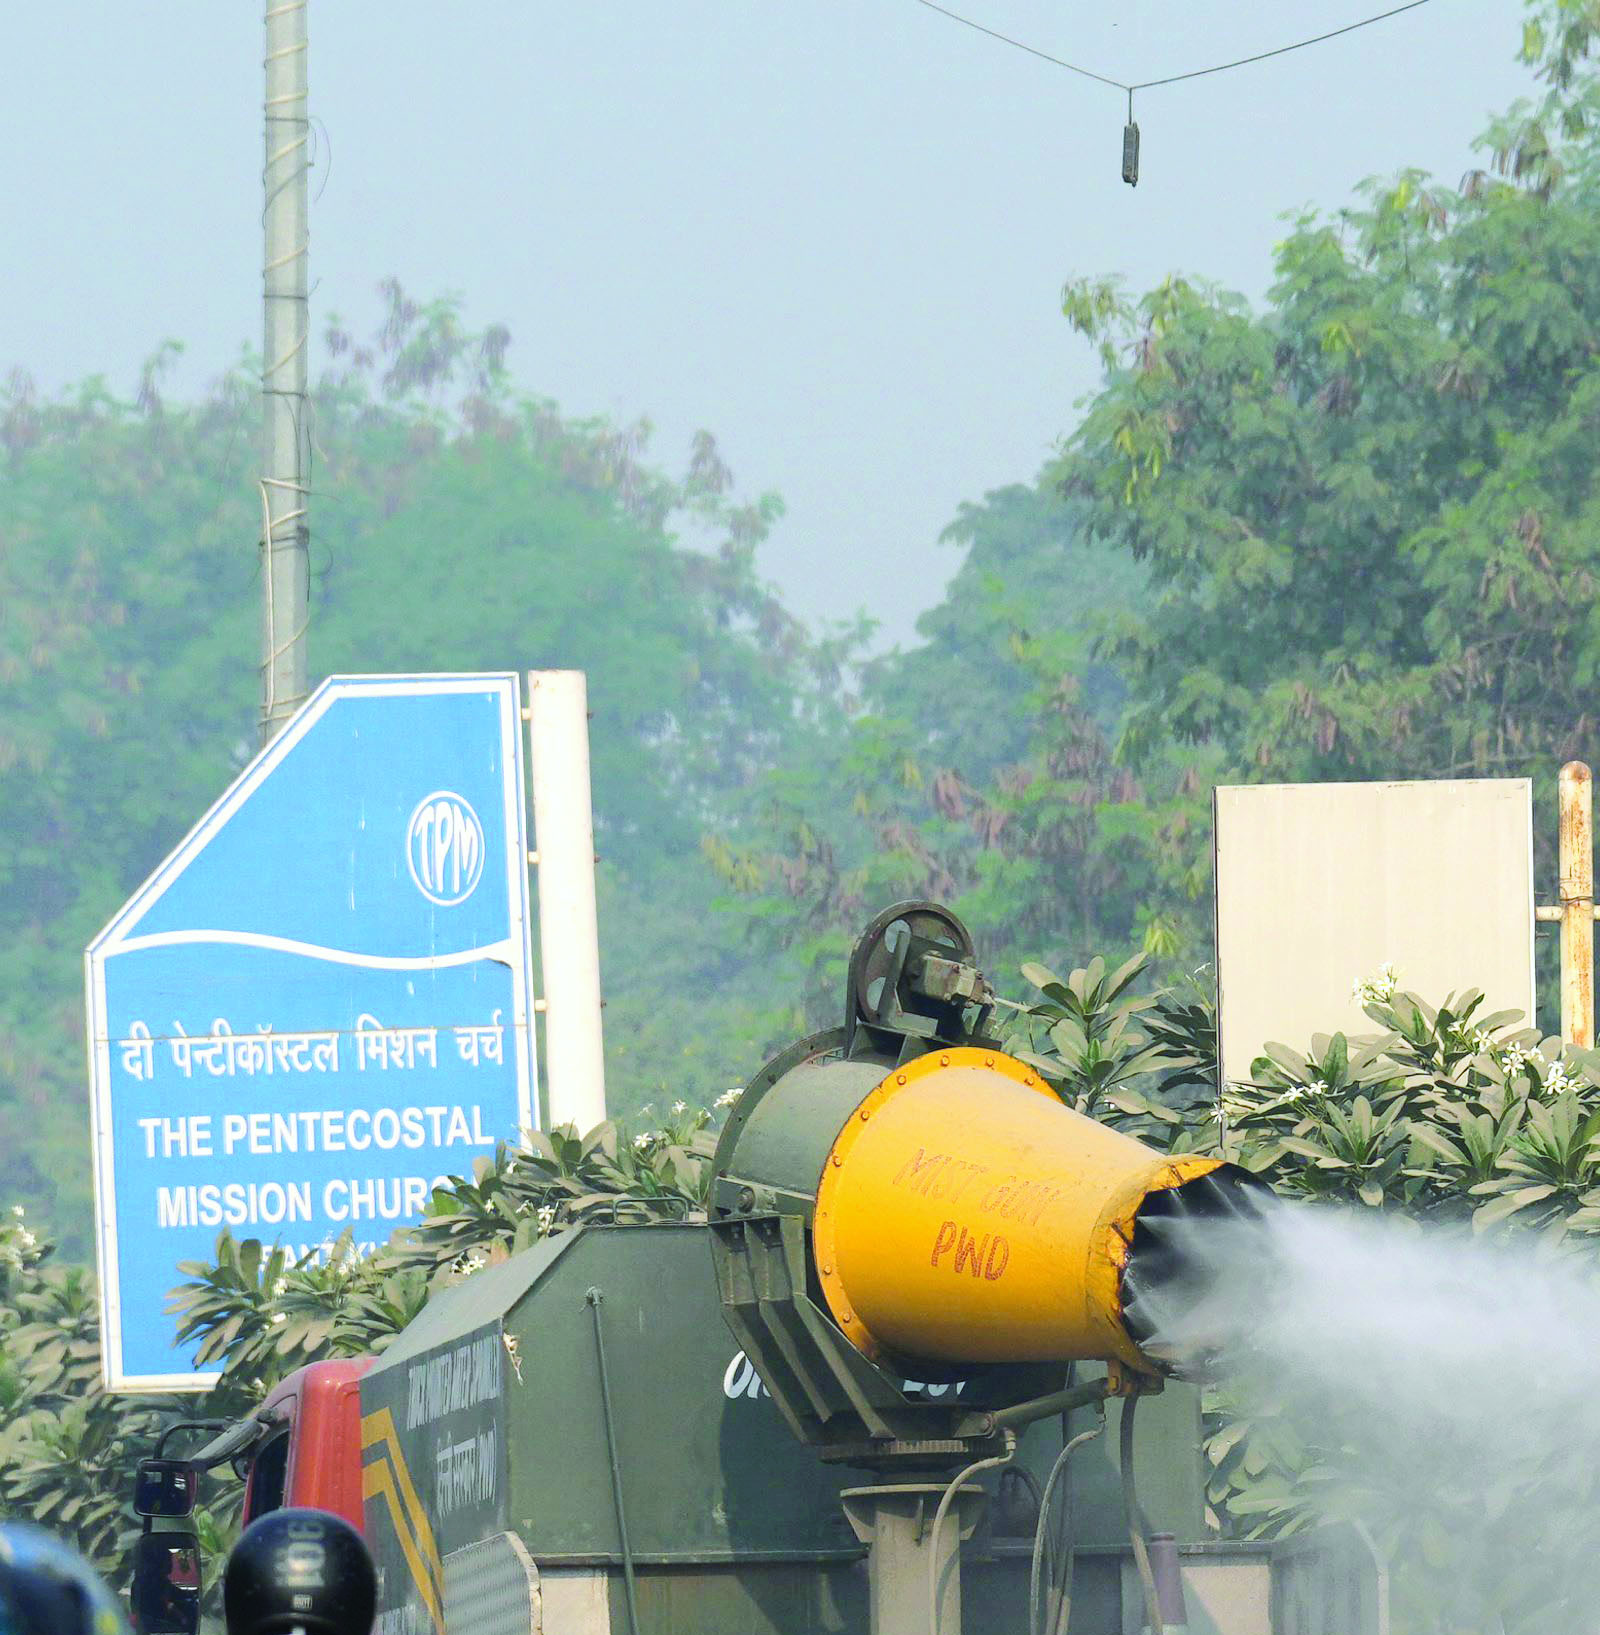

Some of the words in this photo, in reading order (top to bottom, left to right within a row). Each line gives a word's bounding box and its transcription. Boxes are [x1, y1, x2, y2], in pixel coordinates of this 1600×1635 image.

[415, 801, 479, 894] TPM
[119, 1020, 154, 1079] दी
[354, 1012, 438, 1071] मिशन
[453, 1009, 504, 1067] चर्च
[138, 1115, 214, 1158] THE
[223, 1105, 495, 1156] PENTECOSTAL
[156, 1181, 312, 1228] MISSION
[930, 1221, 1010, 1281] PWD
